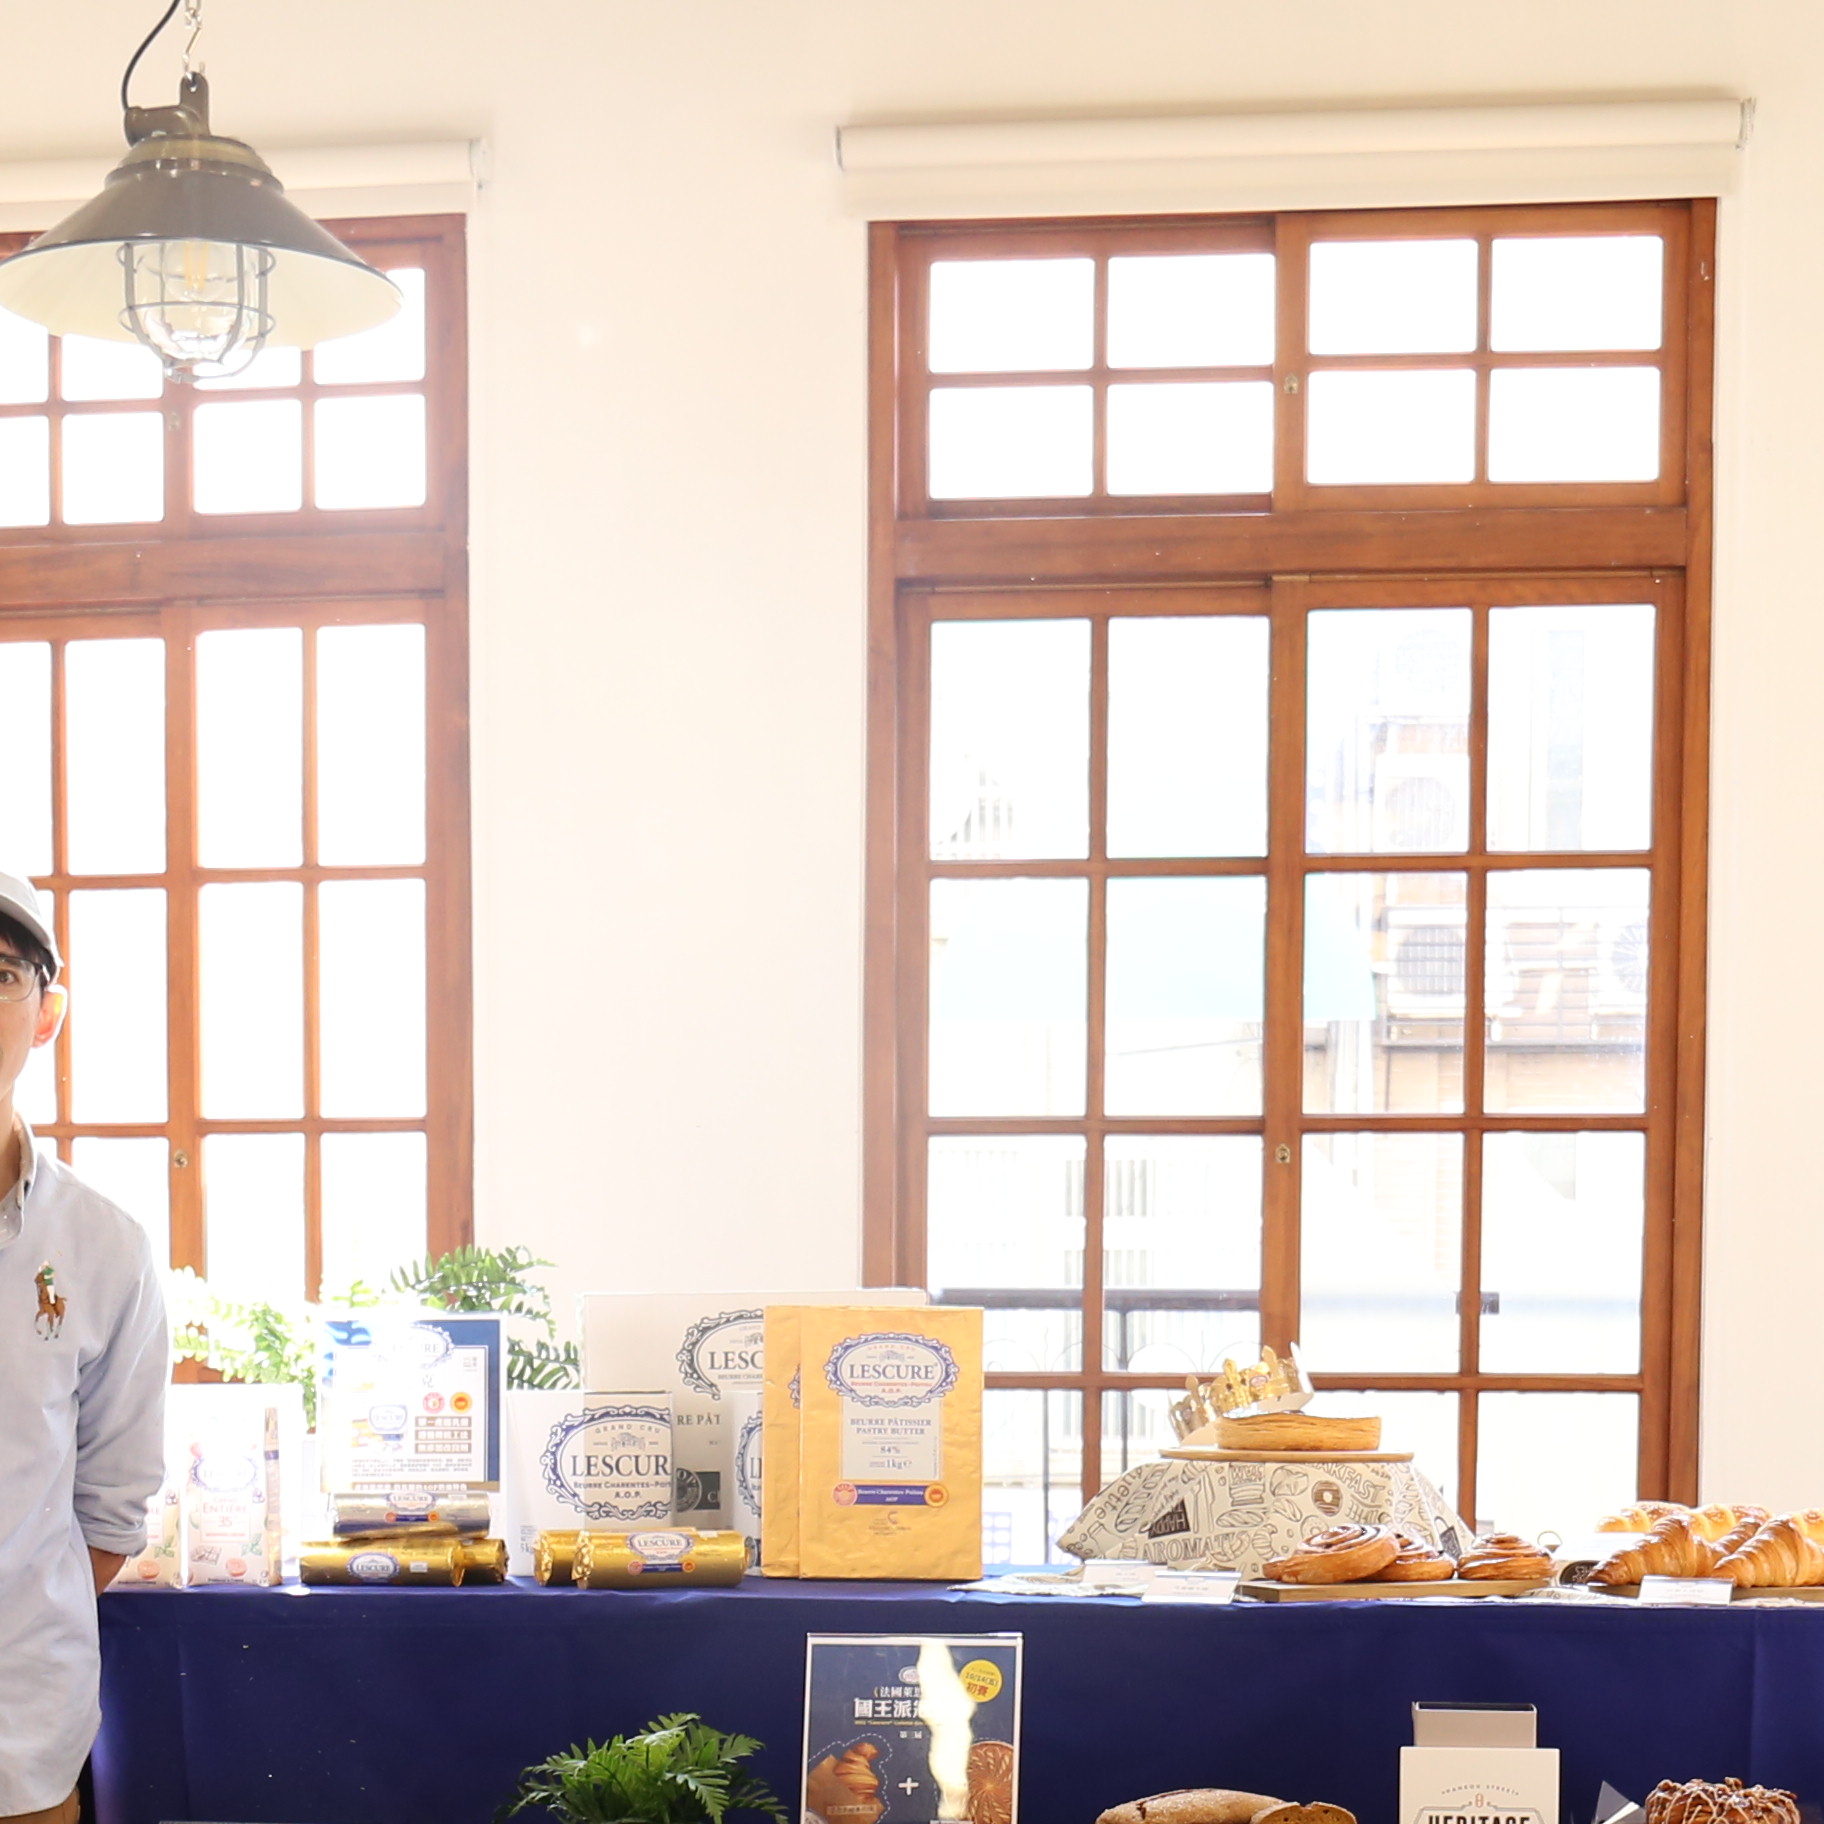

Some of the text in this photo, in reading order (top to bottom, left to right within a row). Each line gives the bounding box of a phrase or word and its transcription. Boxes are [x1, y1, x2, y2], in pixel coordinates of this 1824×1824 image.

[848, 1364, 935, 1380] LESCURE
[853, 1698, 922, 1719] 國王派
